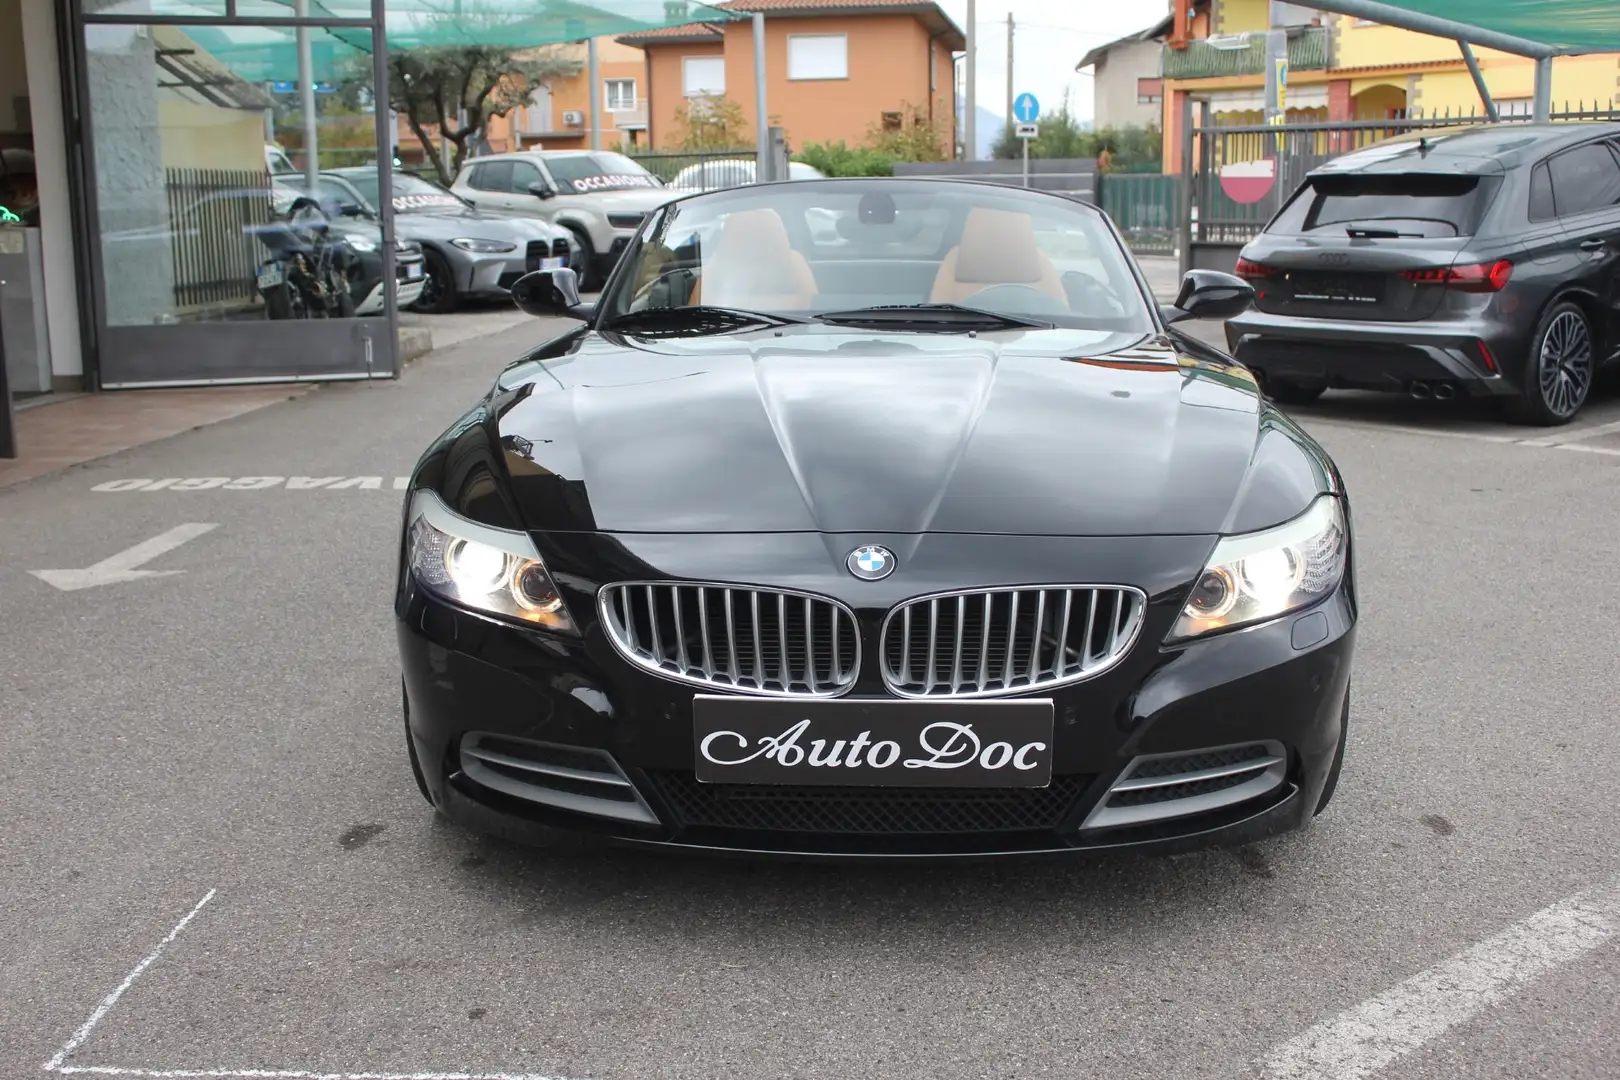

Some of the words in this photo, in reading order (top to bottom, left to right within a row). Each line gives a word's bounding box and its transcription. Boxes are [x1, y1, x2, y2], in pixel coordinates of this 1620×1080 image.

[853, 547, 889, 557] BMW
[700, 718, 900, 769] Auto
[903, 721, 1046, 770] Doc
